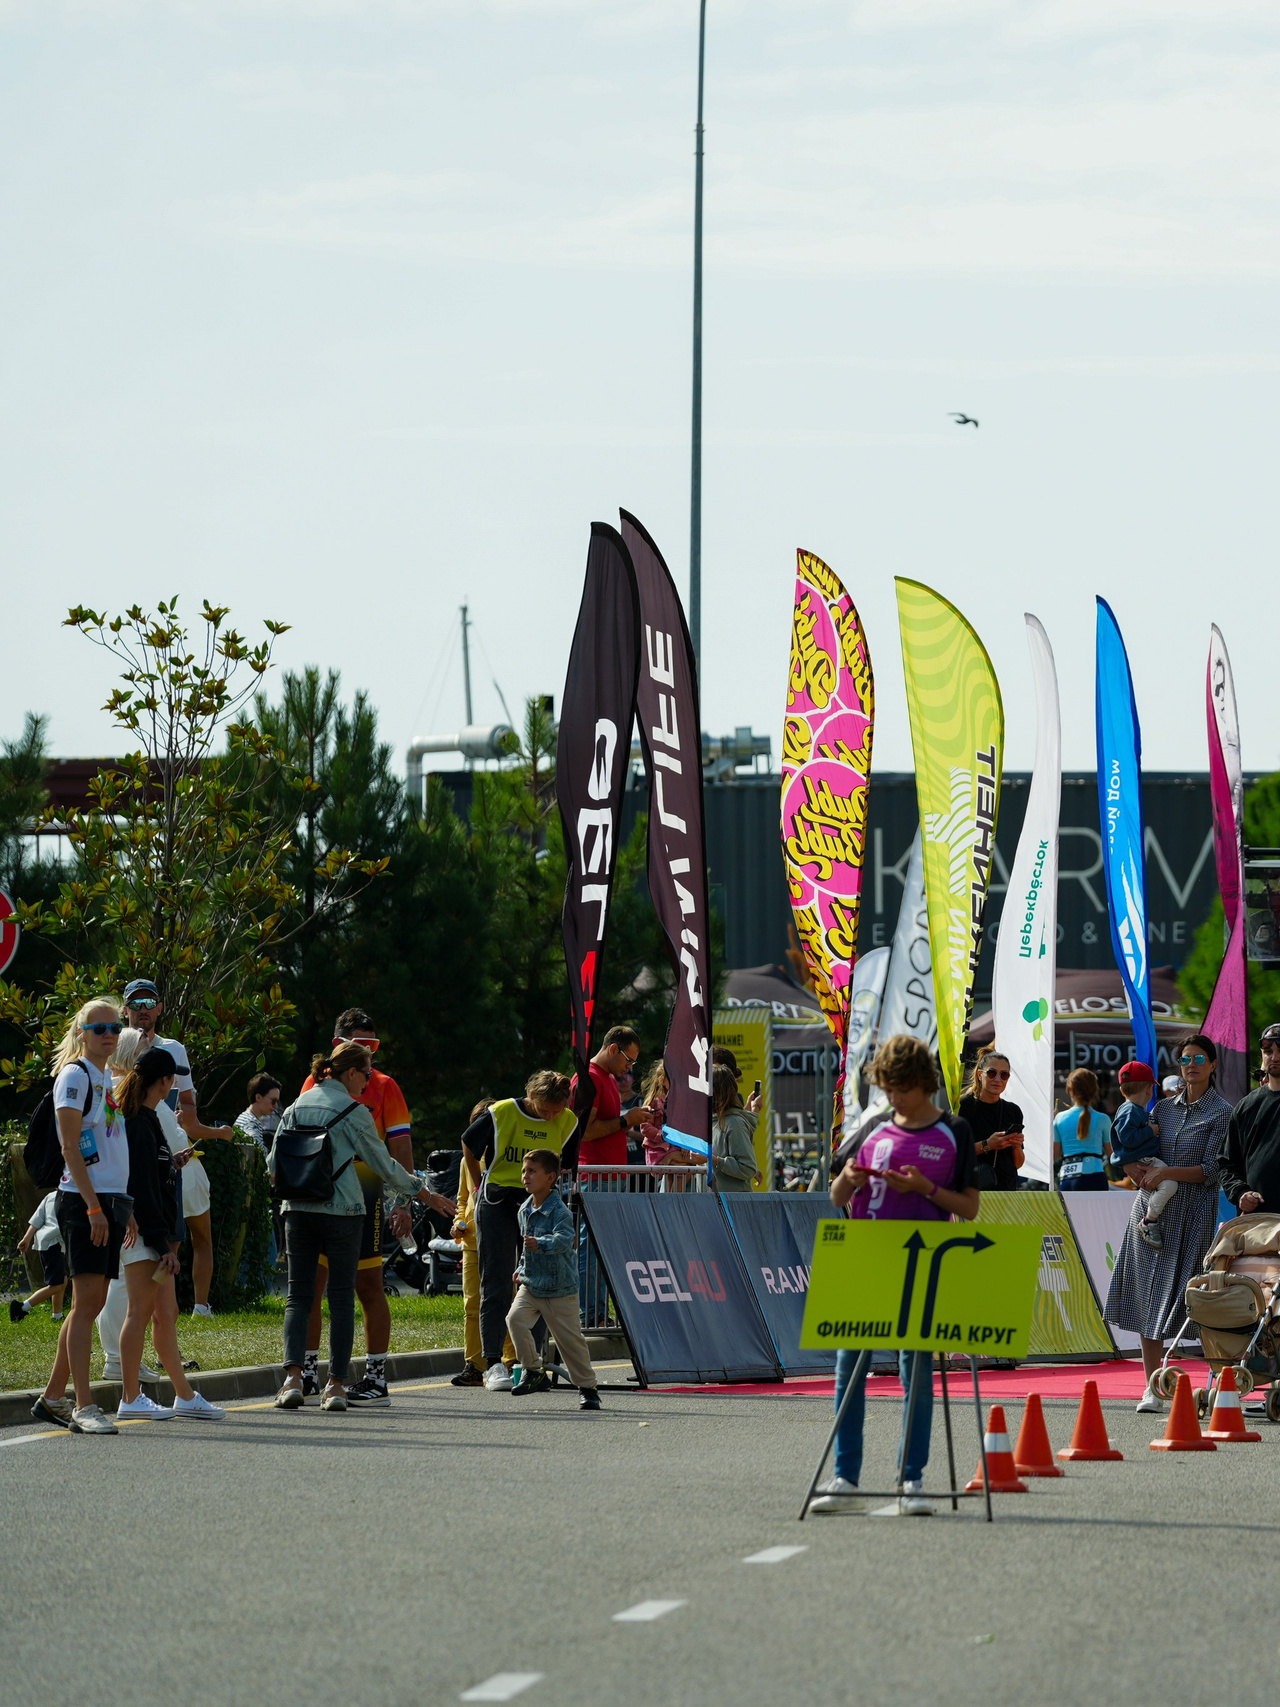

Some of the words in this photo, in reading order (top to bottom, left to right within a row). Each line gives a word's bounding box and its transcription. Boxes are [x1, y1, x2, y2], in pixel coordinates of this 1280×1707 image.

[1076, 1043, 1122, 1067] ЭТО
[919, 1144, 946, 1155] SPORT
[919, 1150, 941, 1161] TEAM
[822, 1231, 846, 1242] STAR
[625, 1260, 727, 1303] GEL4U
[817, 1320, 893, 1338] ФИНИШ
[936, 1323, 962, 1341] НА
[967, 1325, 1017, 1345] КРУГ
